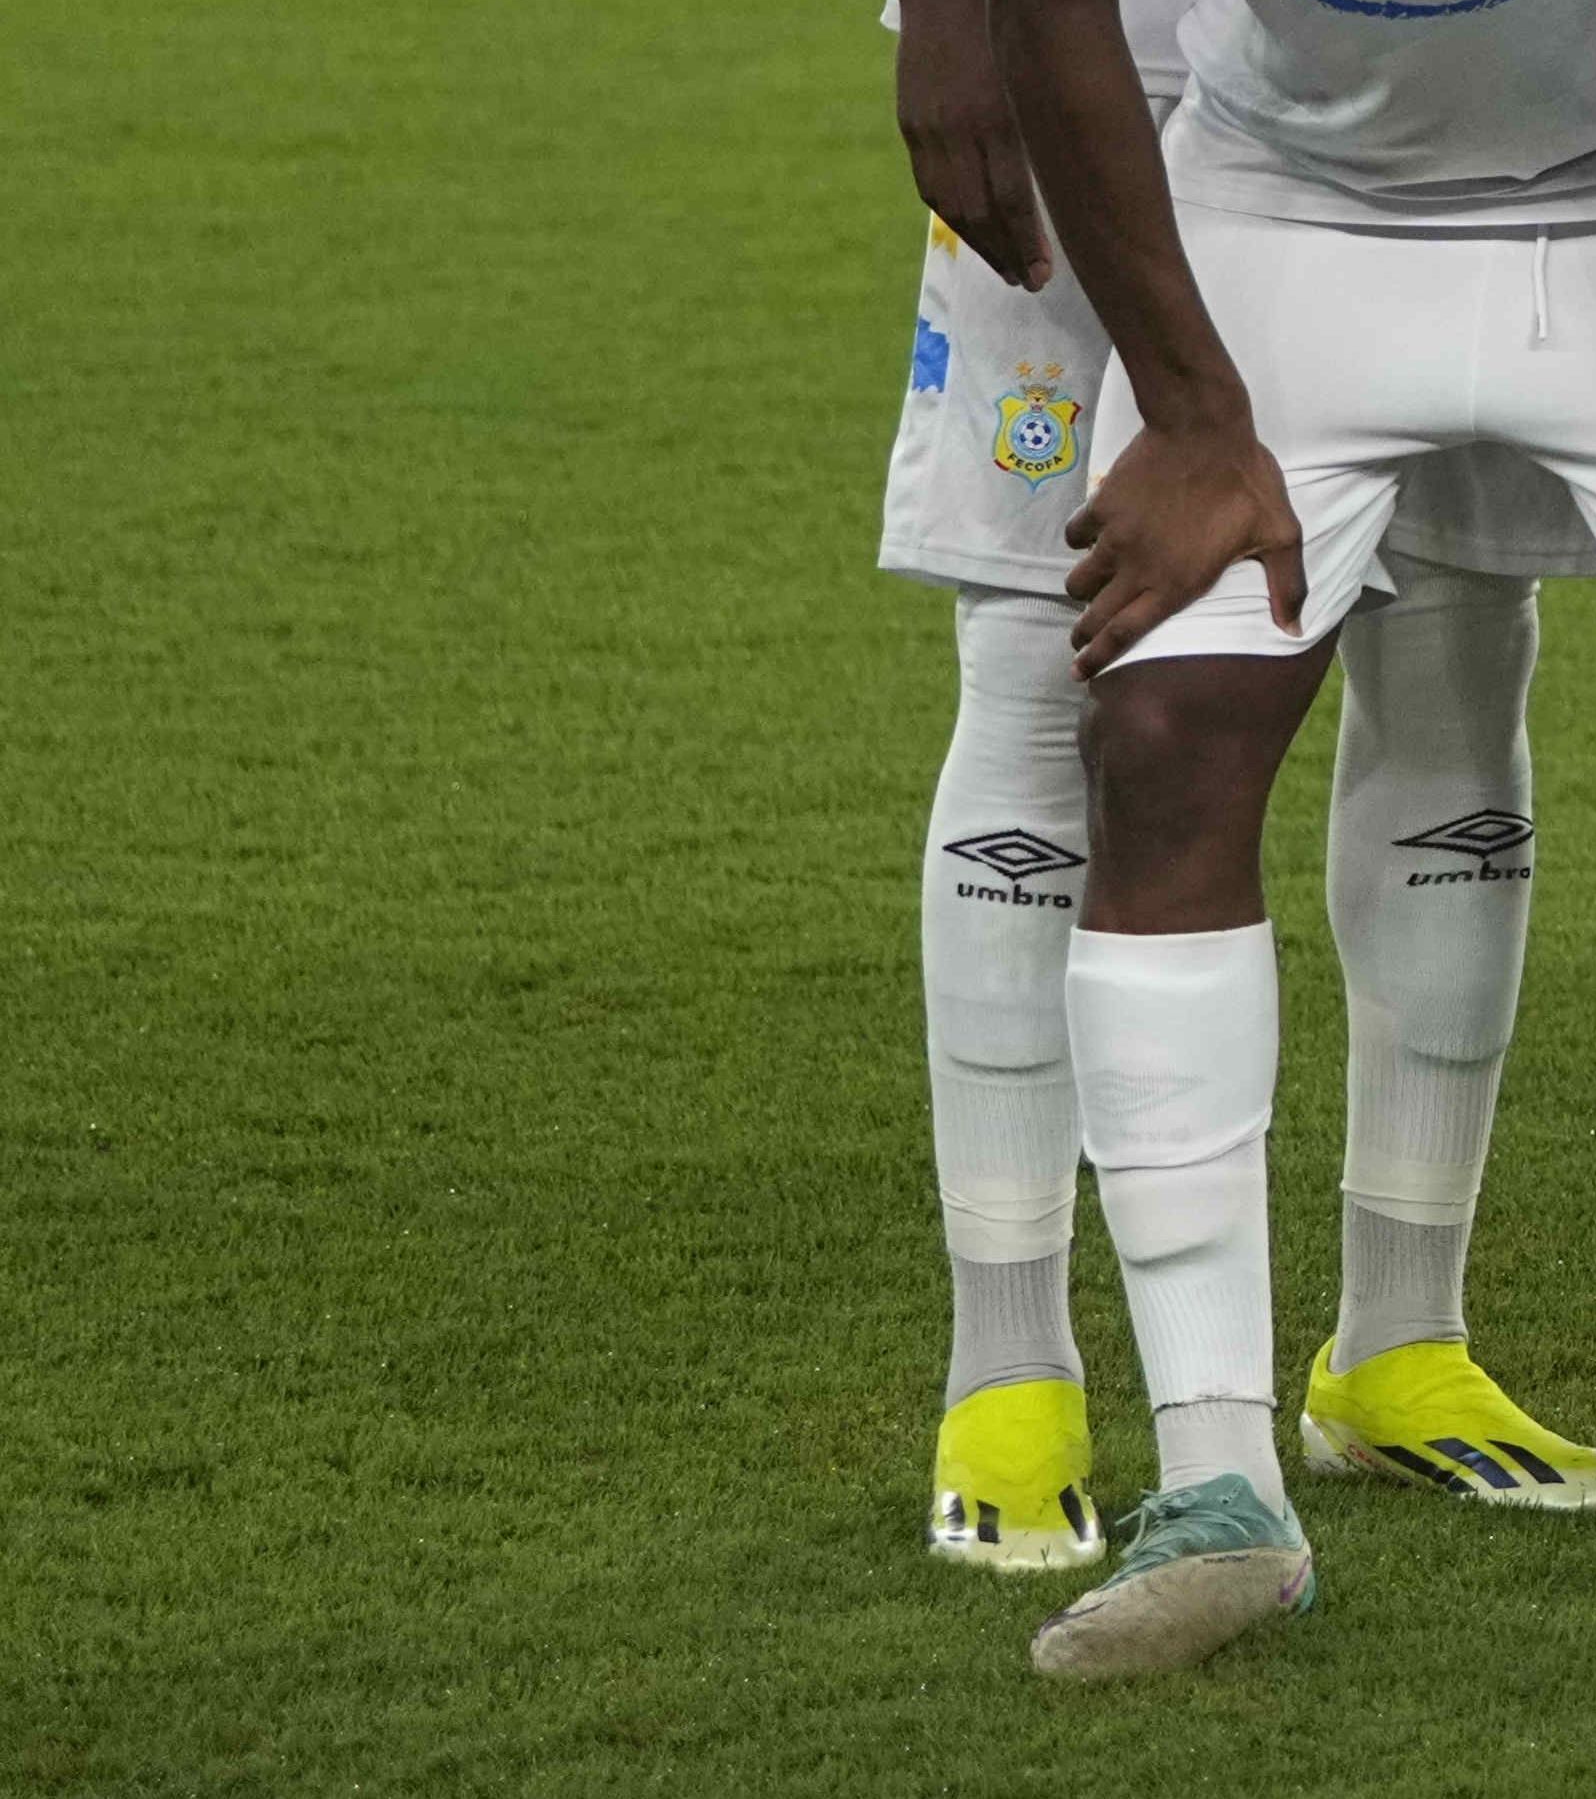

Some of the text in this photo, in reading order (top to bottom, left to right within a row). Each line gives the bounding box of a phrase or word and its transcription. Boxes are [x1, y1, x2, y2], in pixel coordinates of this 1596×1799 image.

[1007, 452, 1063, 472] FECOFA
[1408, 861, 1530, 887] umbro
[956, 881, 1072, 910] umbro
